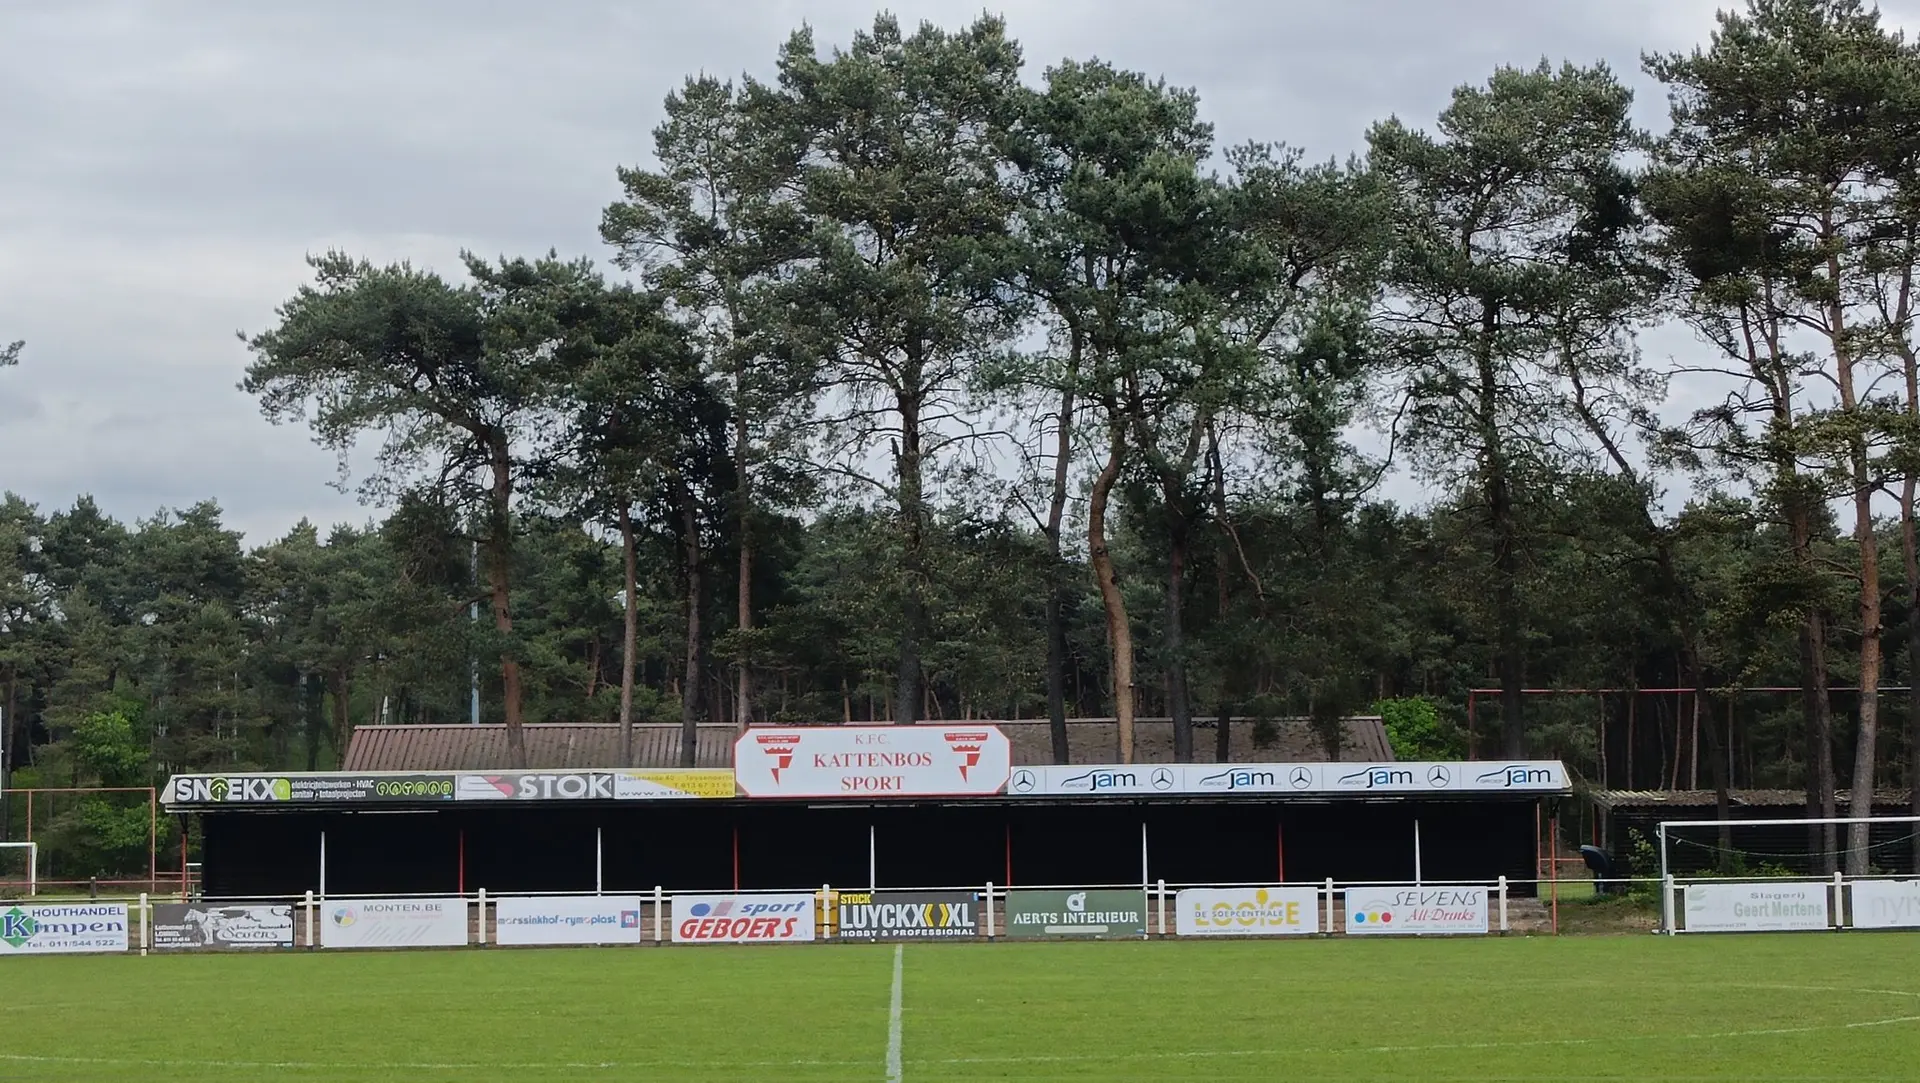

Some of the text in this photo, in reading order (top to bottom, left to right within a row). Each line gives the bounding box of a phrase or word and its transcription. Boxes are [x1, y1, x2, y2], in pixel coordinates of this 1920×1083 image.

[814, 752, 932, 768] KATTENBOS
[356, 779, 374, 788] HVAC
[841, 776, 905, 791] SPORT
[1090, 772, 1136, 791] jam
[1228, 771, 1274, 790] jam
[1366, 770, 1412, 788] jam
[1504, 769, 1551, 787] jam
[518, 774, 612, 798] STOK
[840, 893, 872, 904] STOCK
[1391, 891, 1482, 906] SEVENS
[1750, 892, 1806, 900] Slagerij
[32, 907, 125, 917] HOUTHANDEL
[363, 903, 443, 912] MONTEN.BE
[740, 901, 806, 916] sport
[1212, 910, 1284, 918] SOEPCENTRALE
[1405, 908, 1476, 921] All-Drinks
[1734, 901, 1822, 917] Geert Mertens
[840, 904, 927, 928] LUYCKX
[1013, 911, 1139, 924] AERTS INTERIEUR
[4, 914, 124, 937] Kimpen
[679, 917, 798, 938] GEBOERS
